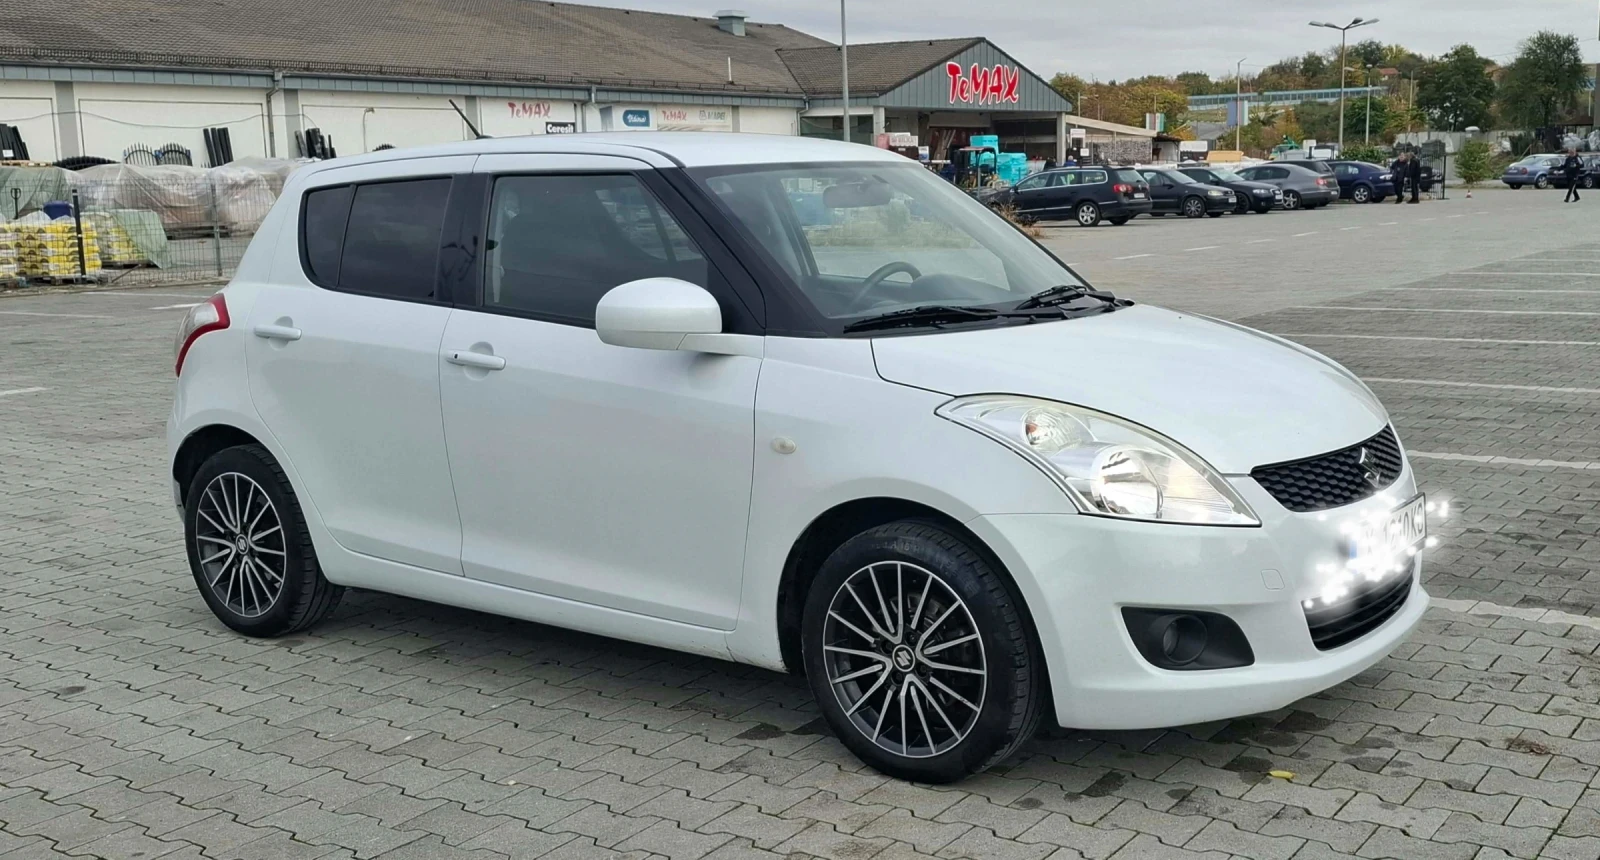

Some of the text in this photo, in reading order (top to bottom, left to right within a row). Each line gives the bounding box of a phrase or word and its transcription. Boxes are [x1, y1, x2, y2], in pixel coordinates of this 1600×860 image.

[946, 62, 1019, 105] TeMAX
[508, 102, 551, 119] TeMAX
[547, 123, 574, 133] Ceresit
